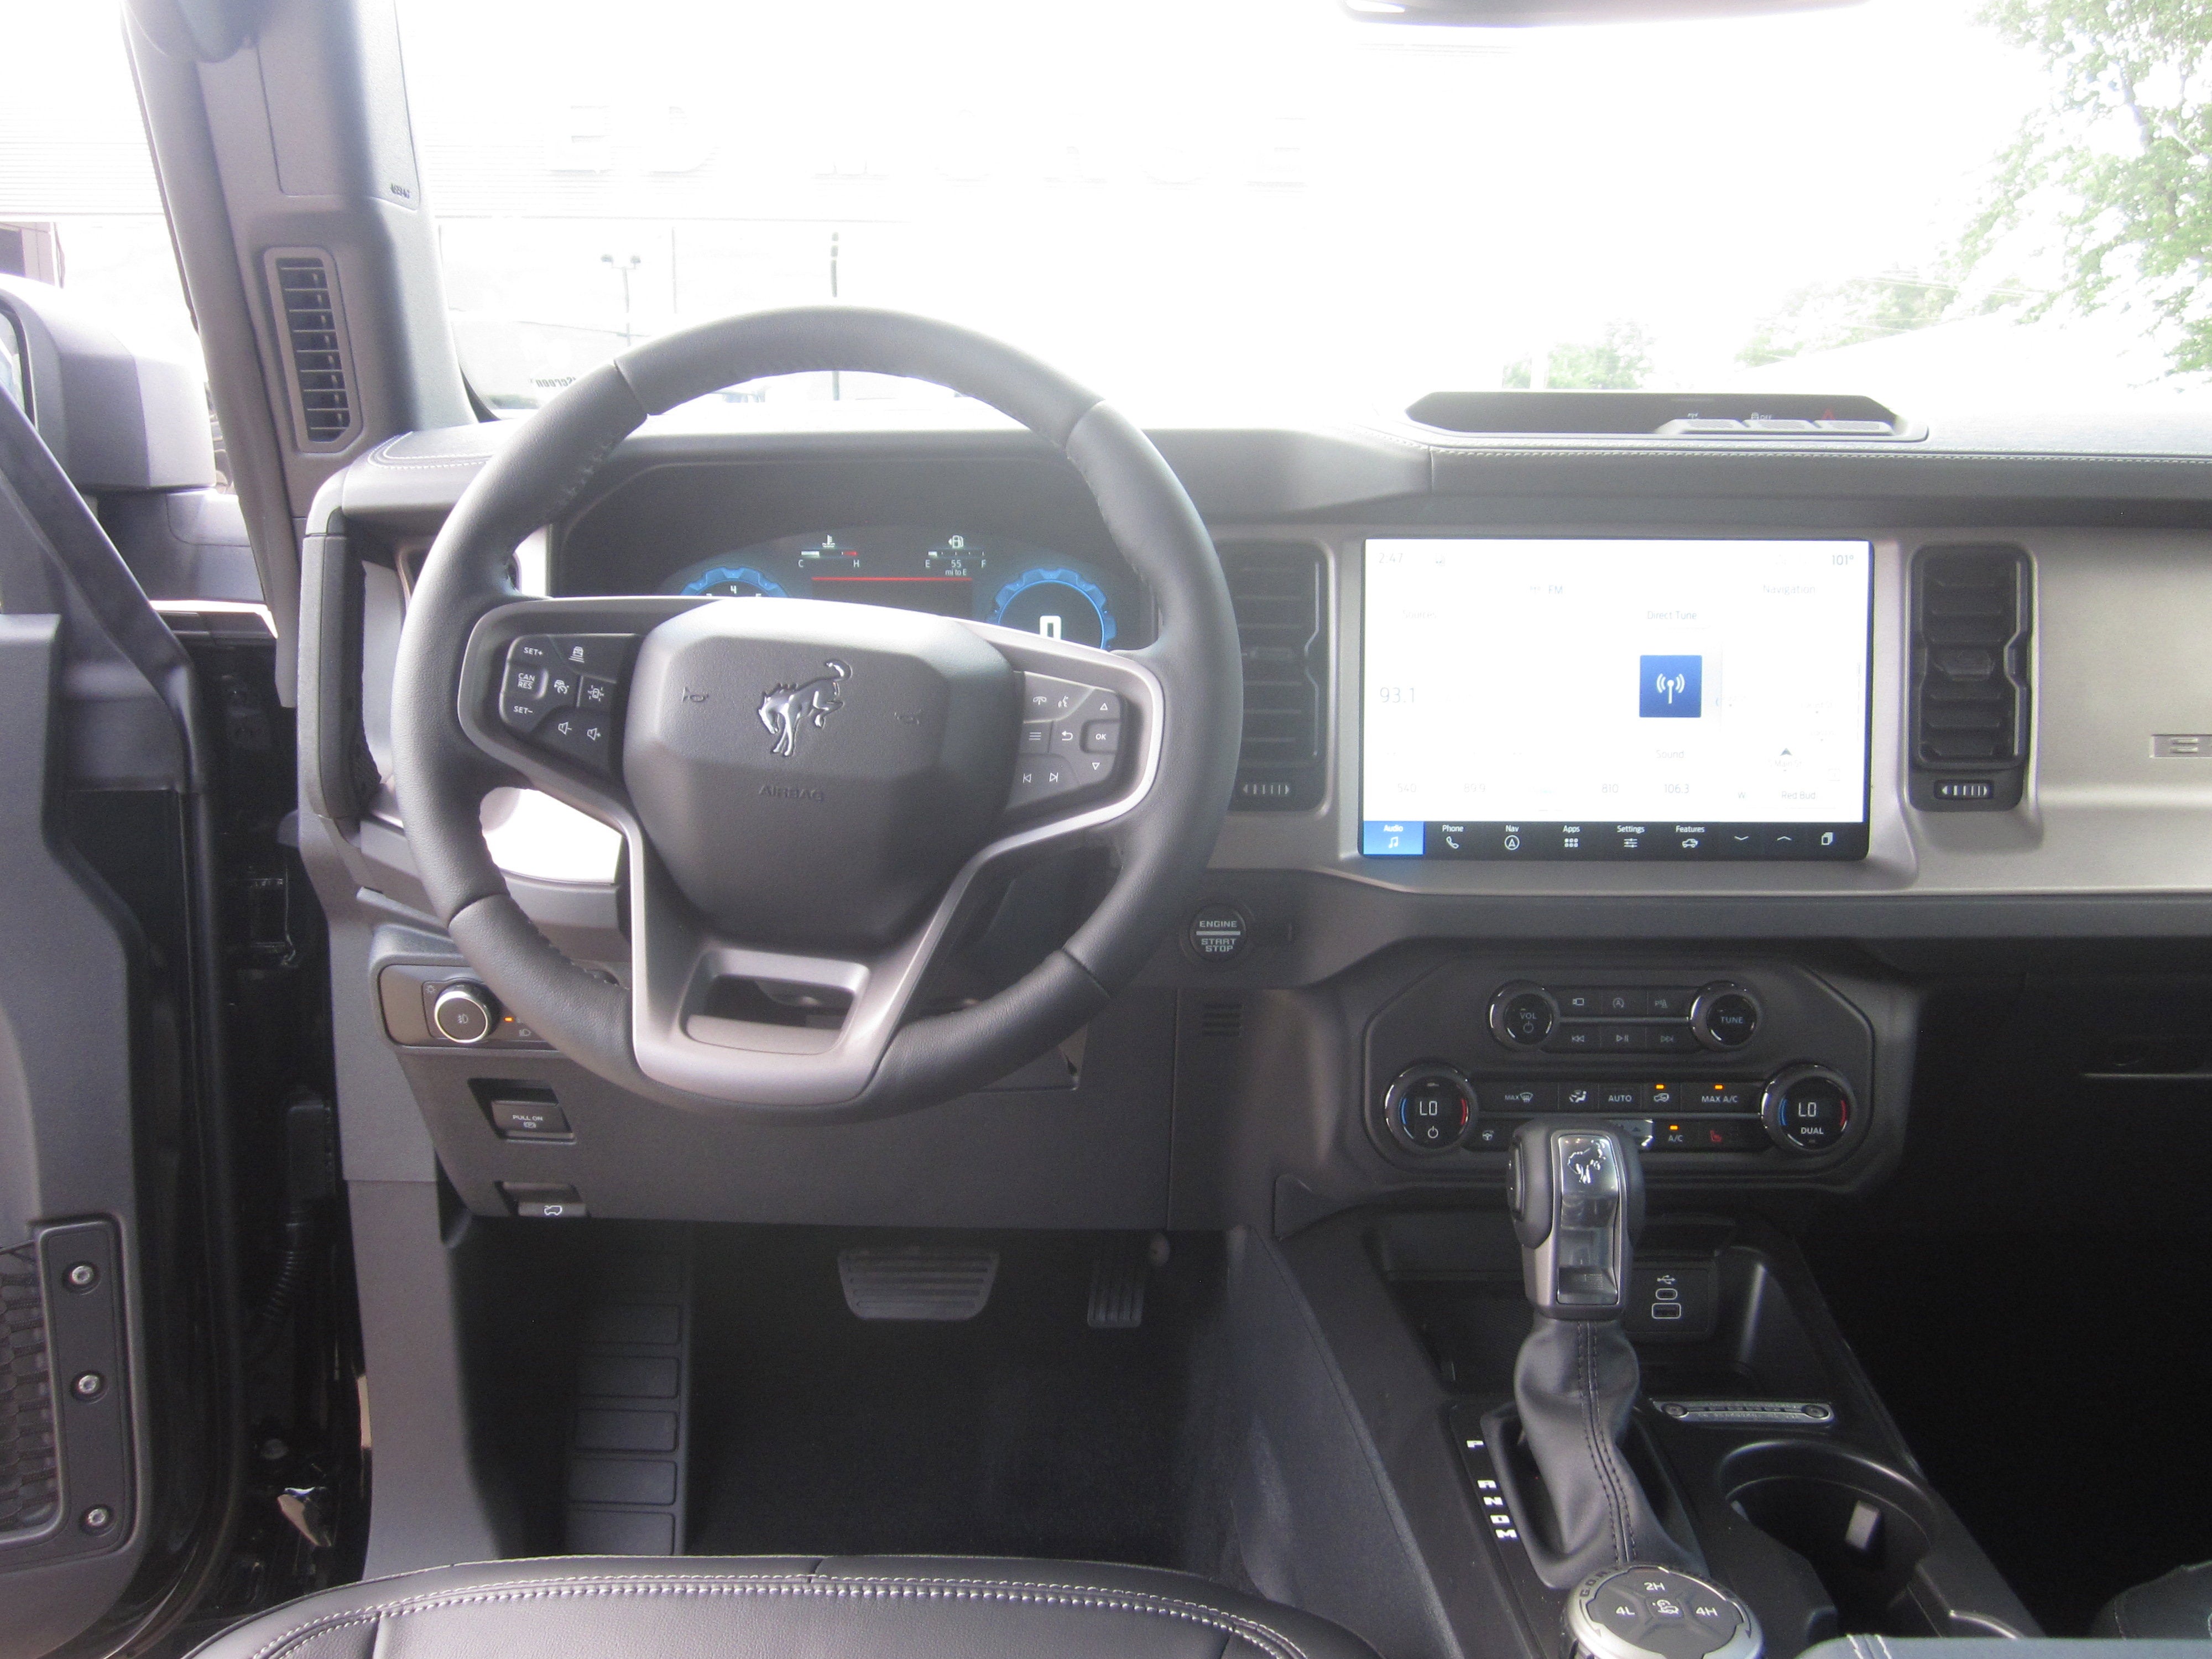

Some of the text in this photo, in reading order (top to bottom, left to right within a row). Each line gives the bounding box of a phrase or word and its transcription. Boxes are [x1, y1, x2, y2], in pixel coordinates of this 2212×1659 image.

[798, 559, 804, 568] C
[853, 559, 859, 568] H
[925, 559, 930, 568] E
[951, 559, 962, 568] 55
[981, 559, 986, 568] F
[730, 585, 737, 594] 4
[1647, 611, 1697, 620] Direct Tune
[518, 672, 535, 682] CAN
[518, 681, 533, 690] RES
[1379, 687, 1415, 703] 93.1
[1656, 750, 1685, 759] Sound
[758, 784, 824, 802] AIRBAG
[1601, 784, 1618, 793] 810
[1664, 784, 1689, 794] 106.3
[1781, 791, 1816, 800] Red Bud
[1563, 825, 1580, 833] Apps
[1616, 825, 1645, 834] Settings
[1608, 1094, 1632, 1103] AUTO
[1701, 1095, 1738, 1103] MAX A/C
[1420, 1100, 1438, 1116] LO
[1798, 1102, 1817, 1117] LO
[1801, 1126, 1824, 1135] DUAL
[1467, 1440, 1484, 1448] P
[1483, 1496, 1504, 1506] N
[1490, 1514, 1510, 1524] D
[1495, 1529, 1517, 1538] M
[1644, 1582, 1665, 1592] 2H
[1615, 1606, 1635, 1615] 4L
[1695, 1606, 1718, 1616] 4H
